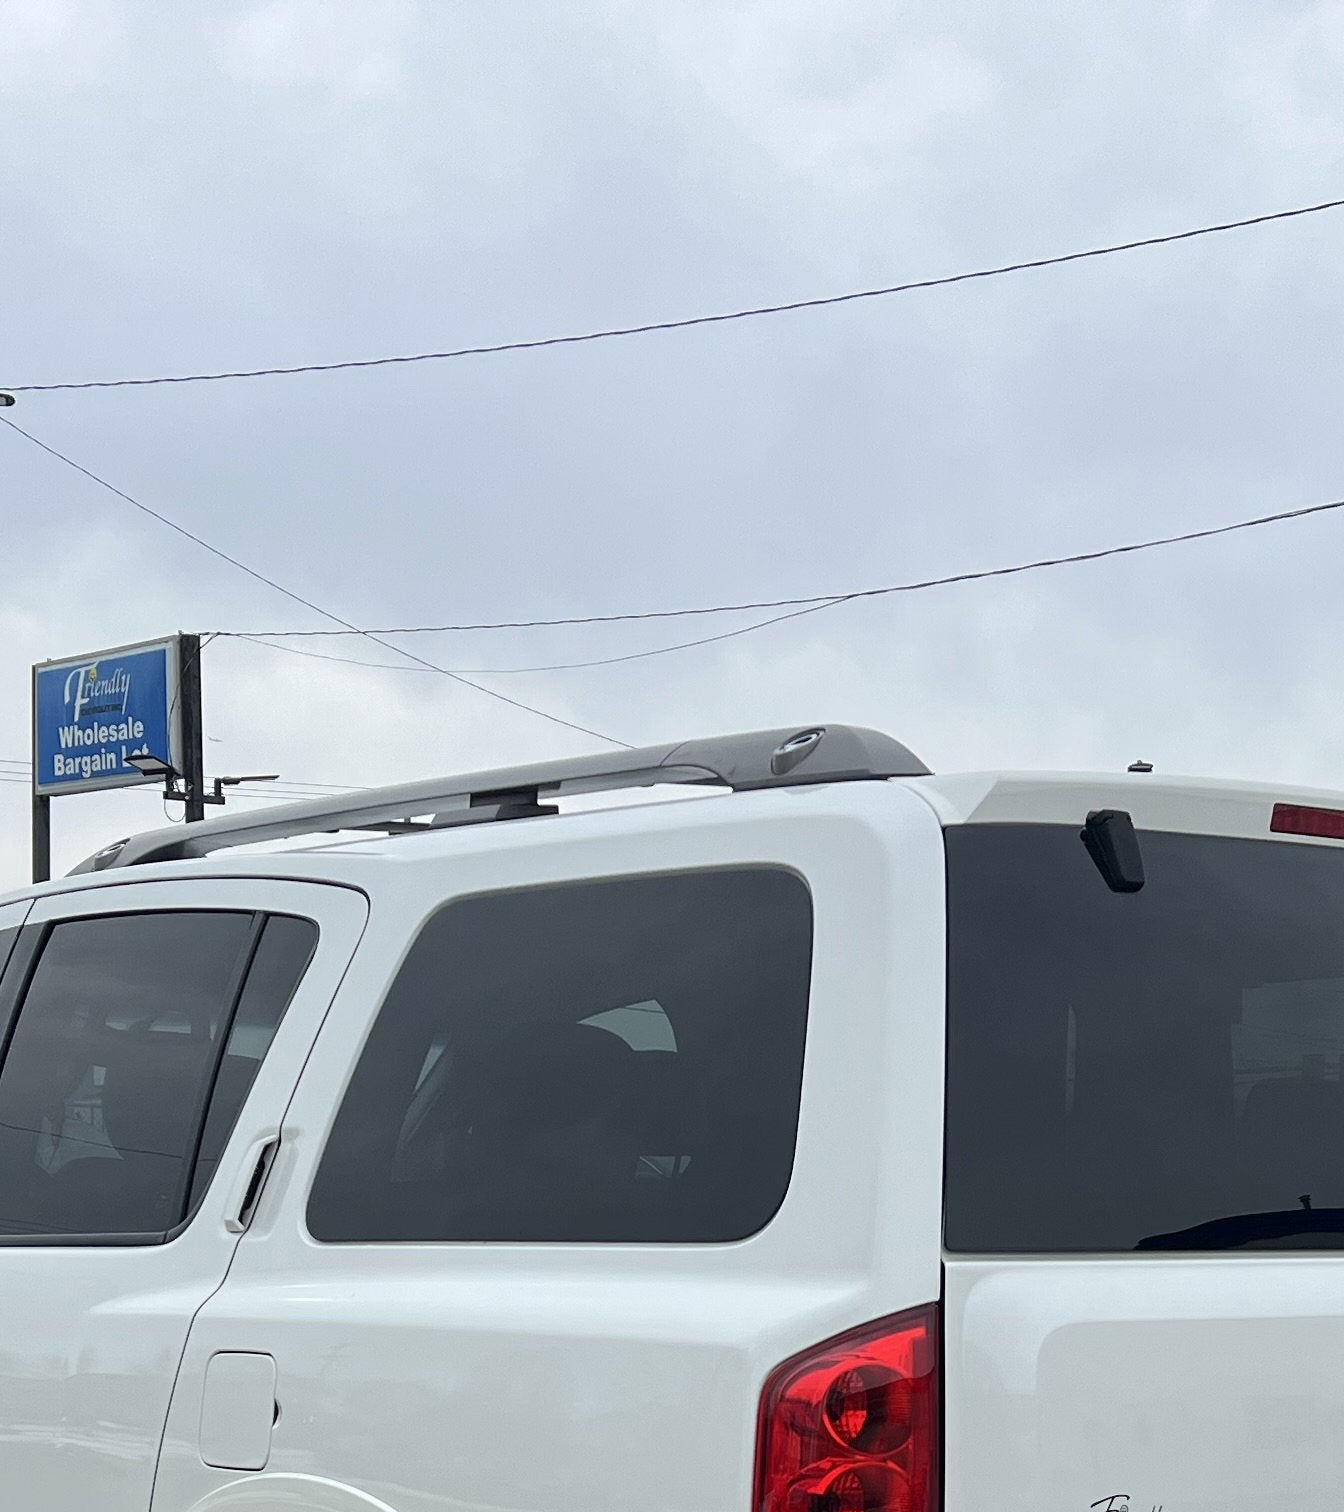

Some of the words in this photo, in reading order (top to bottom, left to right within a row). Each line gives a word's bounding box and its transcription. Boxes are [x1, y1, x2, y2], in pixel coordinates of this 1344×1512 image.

[64, 661, 130, 722] Friendly
[59, 716, 144, 749] Wholesale
[54, 747, 116, 778] Bargain
